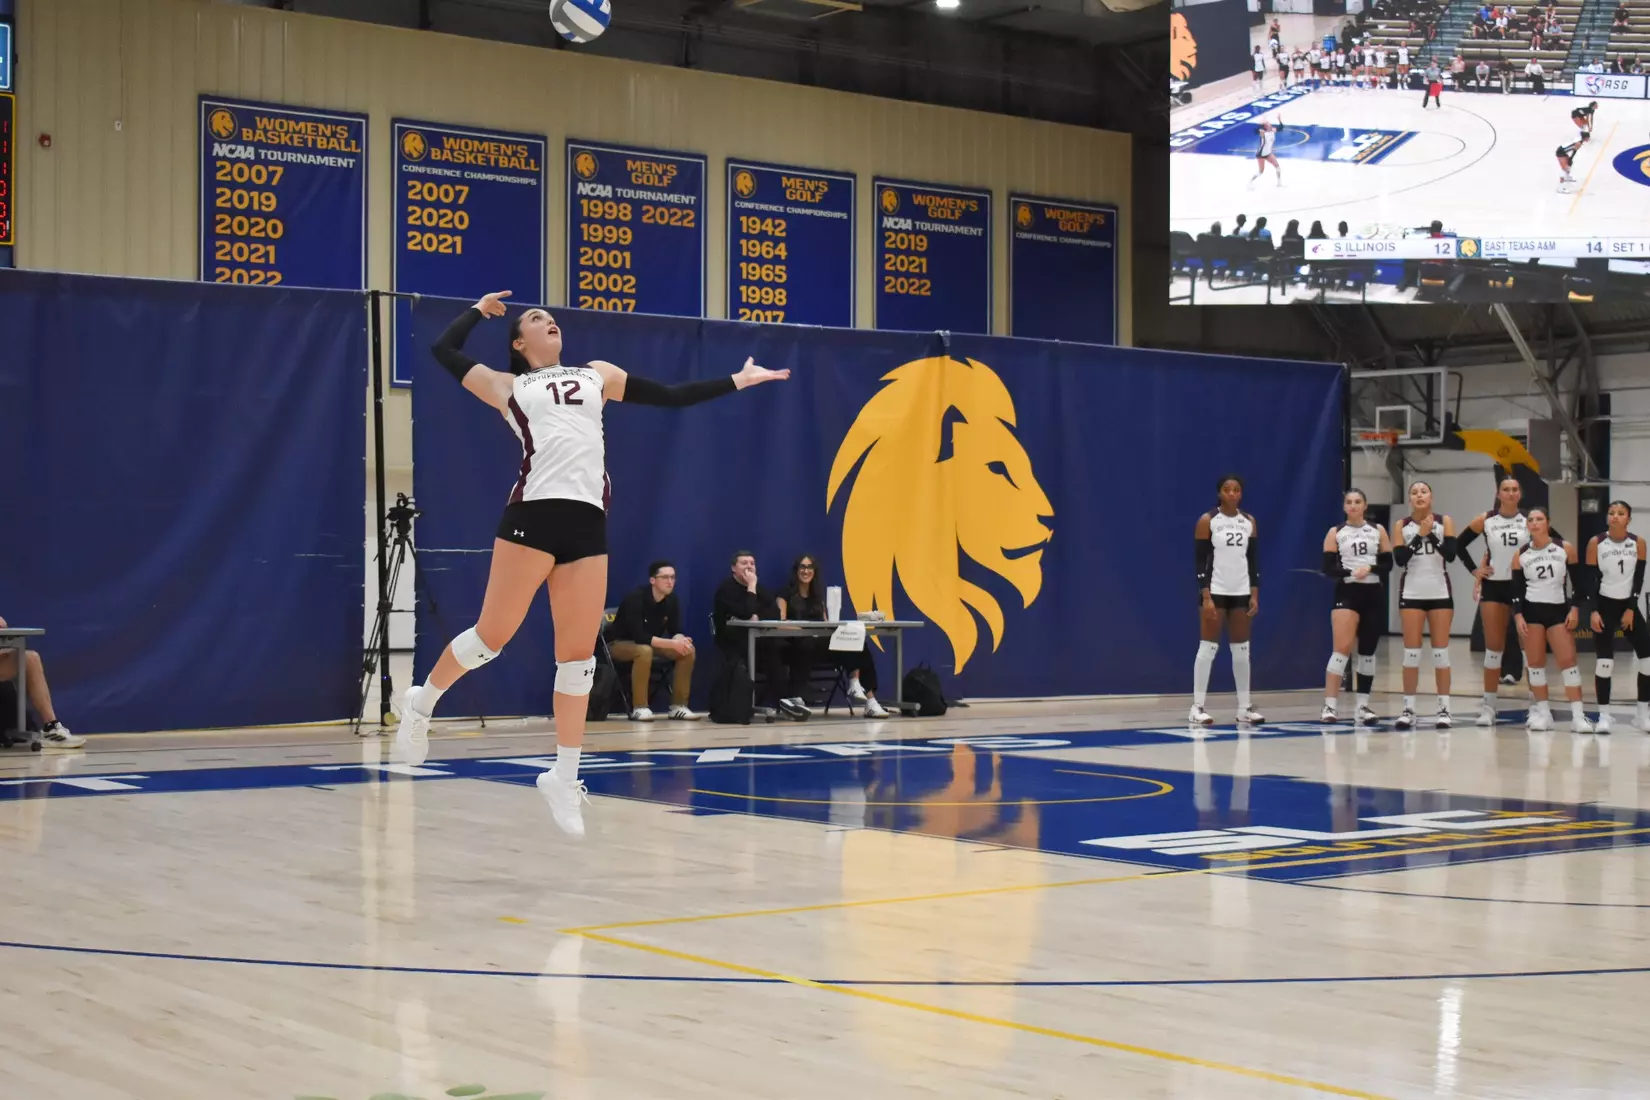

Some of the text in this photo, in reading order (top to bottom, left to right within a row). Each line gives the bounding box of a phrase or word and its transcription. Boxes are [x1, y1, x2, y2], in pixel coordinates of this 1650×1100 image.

[1605, 79, 1629, 90] ASG
[255, 116, 349, 139] WOMEN'S
[241, 128, 361, 153] BASKETBALL
[443, 136, 529, 157] WOMEN'S
[212, 143, 356, 168] NCAA TOURNAMENT
[431, 147, 540, 171] BASKETBALL
[215, 161, 284, 186] 2007
[402, 164, 537, 186] CONFERENCE CHAMPIONSHIPS
[626, 159, 678, 176] MEN'S
[631, 171, 672, 187] GOLF
[782, 176, 828, 193] MEN'S
[215, 187, 277, 212] 2019
[407, 180, 469, 205] 2007
[577, 182, 696, 205] NCAA TOURNAMENT
[786, 188, 824, 203] GOLF
[912, 193, 978, 212] WOMEN'S
[407, 206, 469, 230] 2020
[580, 199, 695, 227] 1998 2022
[735, 201, 847, 220] CONFERENCE CHAMPIONSHIPS
[928, 205, 962, 220] GOLF
[1044, 208, 1105, 225] WOMEN'S
[215, 214, 284, 239] 2020
[580, 223, 632, 245] 1999
[739, 216, 787, 237] 1942
[883, 216, 983, 236] NCAA TOURNAMENT
[1058, 220, 1090, 233] GOLF
[407, 231, 462, 254] 2021
[884, 232, 928, 252] 2019
[1015, 231, 1058, 243] CONFERENCE
[215, 241, 276, 265] 2021
[740, 239, 787, 260] 1964
[1334, 242, 1450, 254] S ILLINOIS 12
[1485, 241, 1506, 251] EAST
[1509, 241, 1535, 251] TEXAS
[1537, 241, 1556, 251] A&M
[1586, 242, 1603, 254] 14
[1612, 243, 1635, 253] SET
[579, 247, 631, 269] 2001
[884, 254, 927, 273] 2021
[215, 267, 283, 286] 2022
[579, 271, 636, 293] 2002
[739, 262, 787, 283] 1965
[739, 285, 787, 306] 1998
[884, 276, 931, 296] 2022
[579, 296, 636, 313] 2007
[738, 308, 785, 324] 2017
[545, 380, 584, 405] 12
[1226, 532, 1243, 547] 22
[1350, 541, 1368, 556] 18
[1500, 532, 1519, 547] 15
[1536, 564, 1555, 580] 21
[1617, 559, 1624, 575] 1
[1078, 809, 1575, 856] SLC
[1200, 819, 1636, 862] SOUTHLAND
